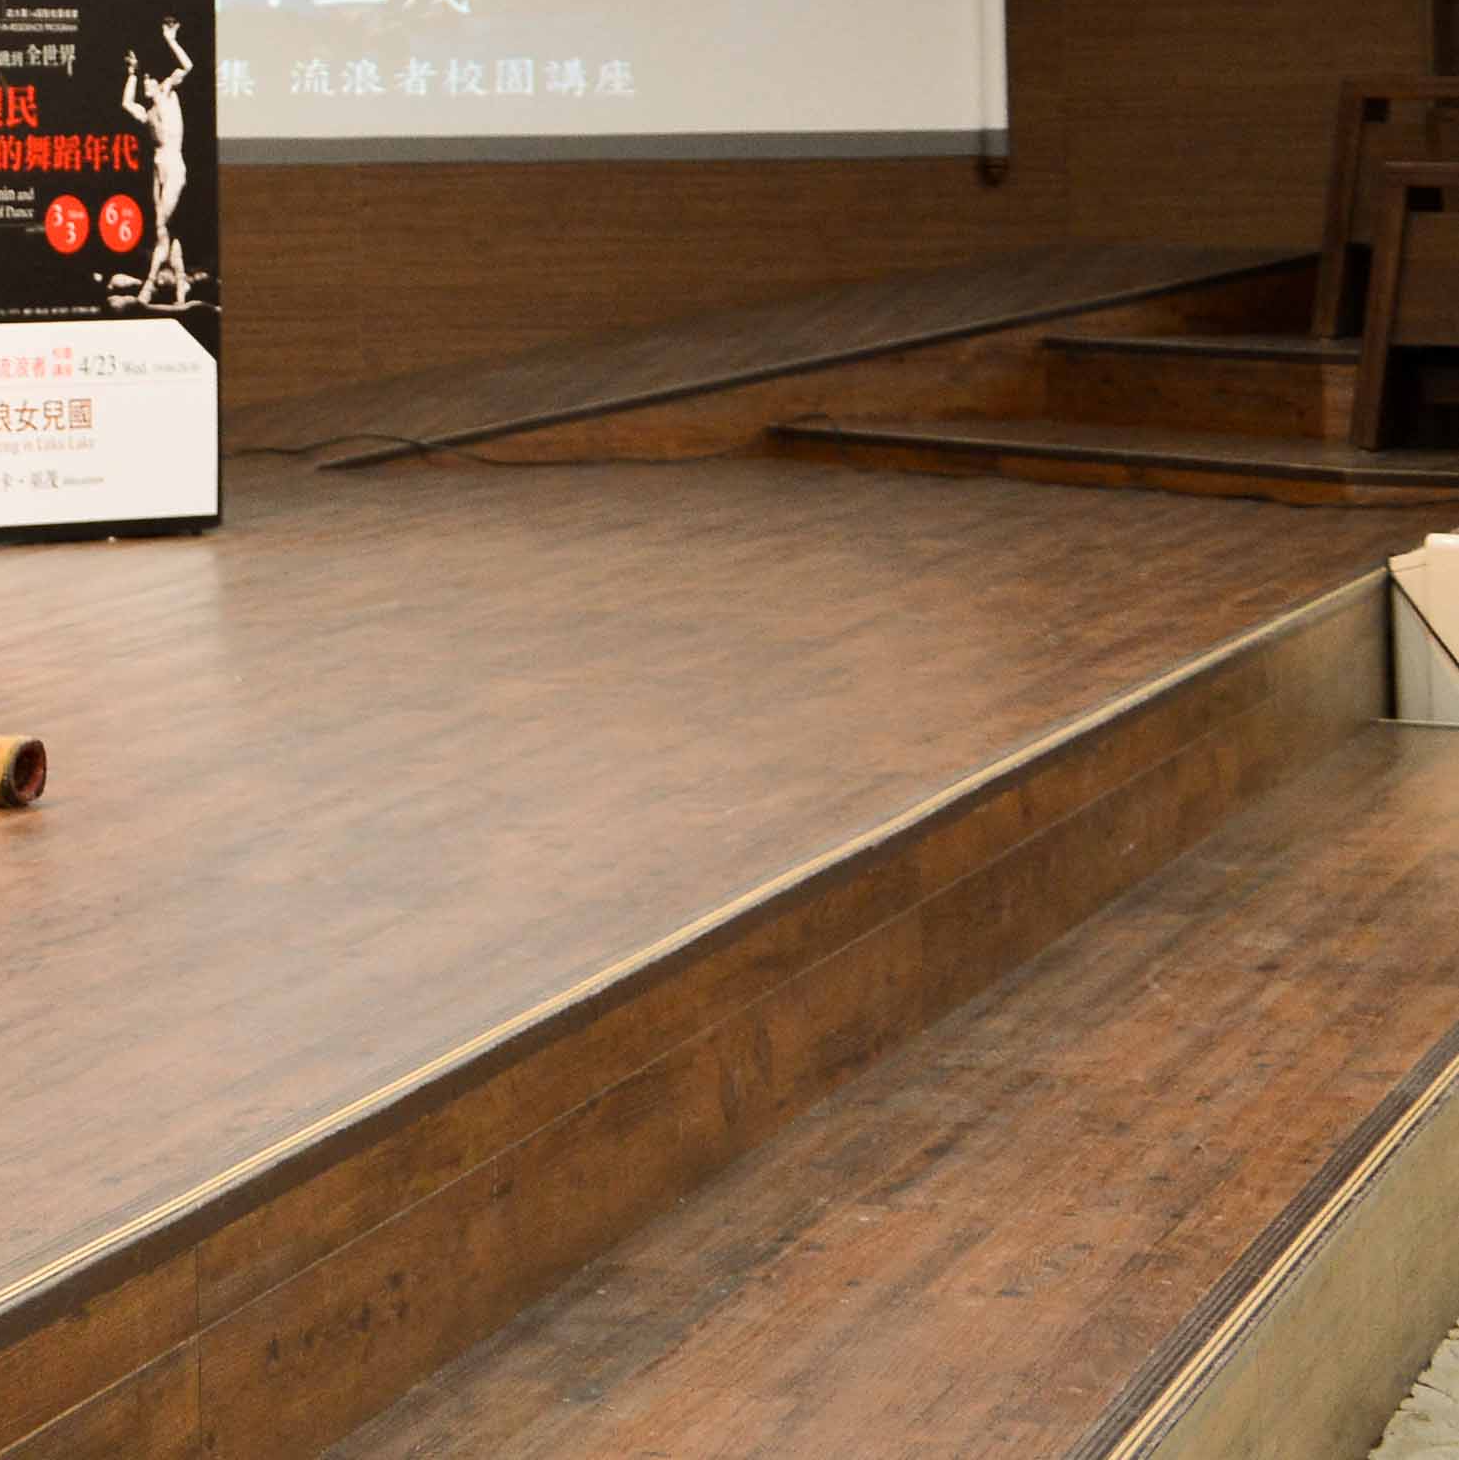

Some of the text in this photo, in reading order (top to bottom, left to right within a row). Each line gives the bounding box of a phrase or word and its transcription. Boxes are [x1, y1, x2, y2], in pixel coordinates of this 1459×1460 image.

[289, 57, 638, 98] 流浪者校園講座
[52, 203, 63, 226] 3
[105, 203, 119, 224] 6
[65, 221, 77, 244] 3
[119, 220, 132, 242] 6
[77, 355, 117, 376] 4/23
